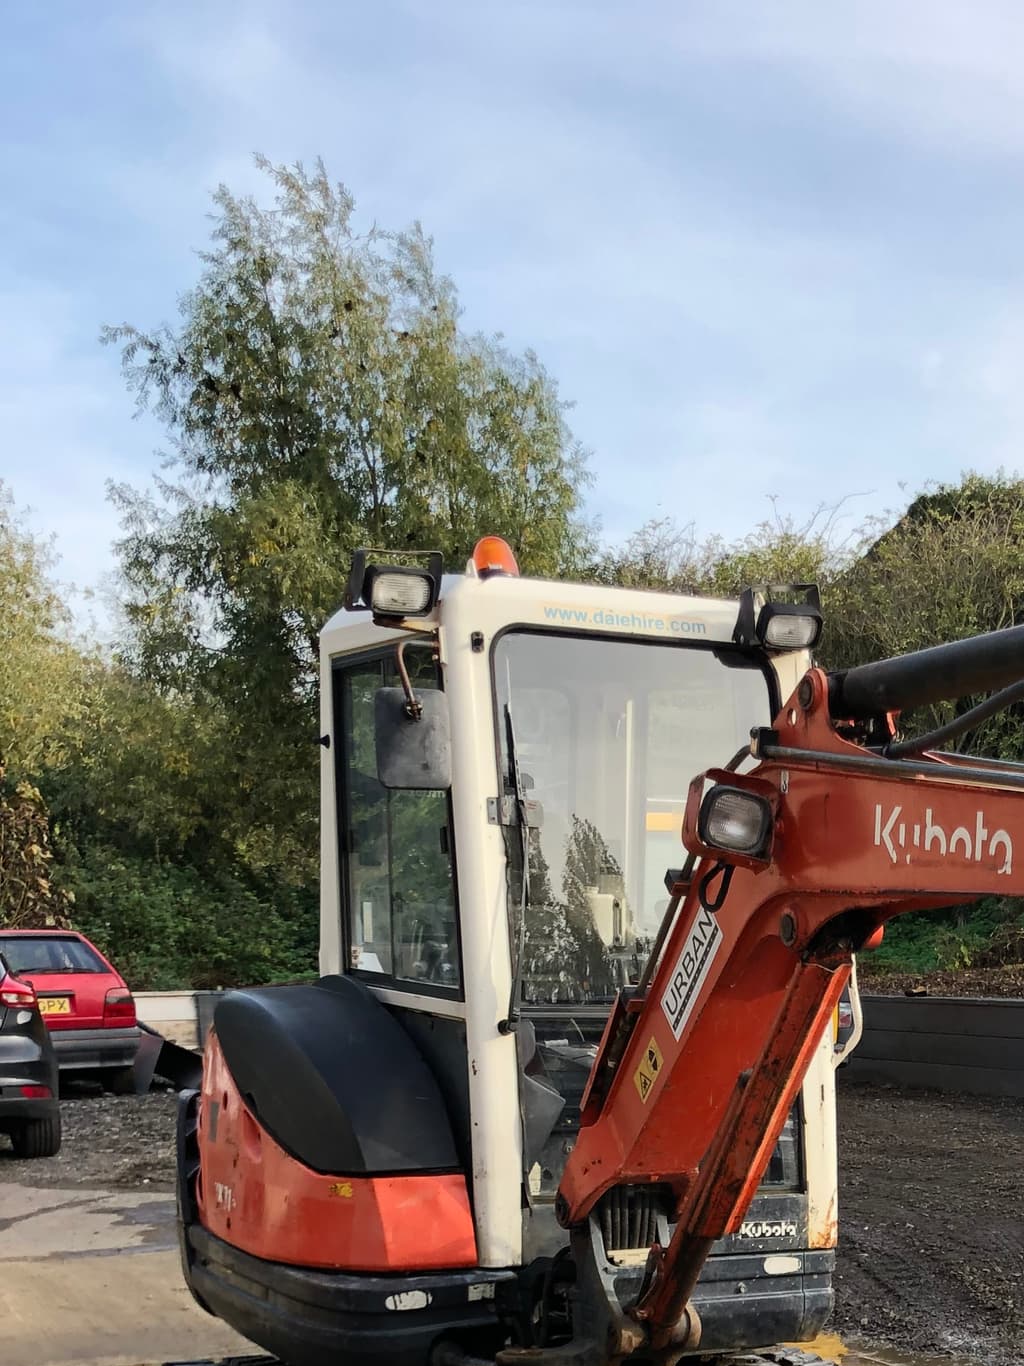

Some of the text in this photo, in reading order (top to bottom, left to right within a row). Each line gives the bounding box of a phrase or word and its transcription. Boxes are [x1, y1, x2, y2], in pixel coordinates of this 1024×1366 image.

[665, 911, 713, 1016] URBAN
[39, 999, 68, 1013] GPX
[741, 1222, 797, 1237] Kubota
